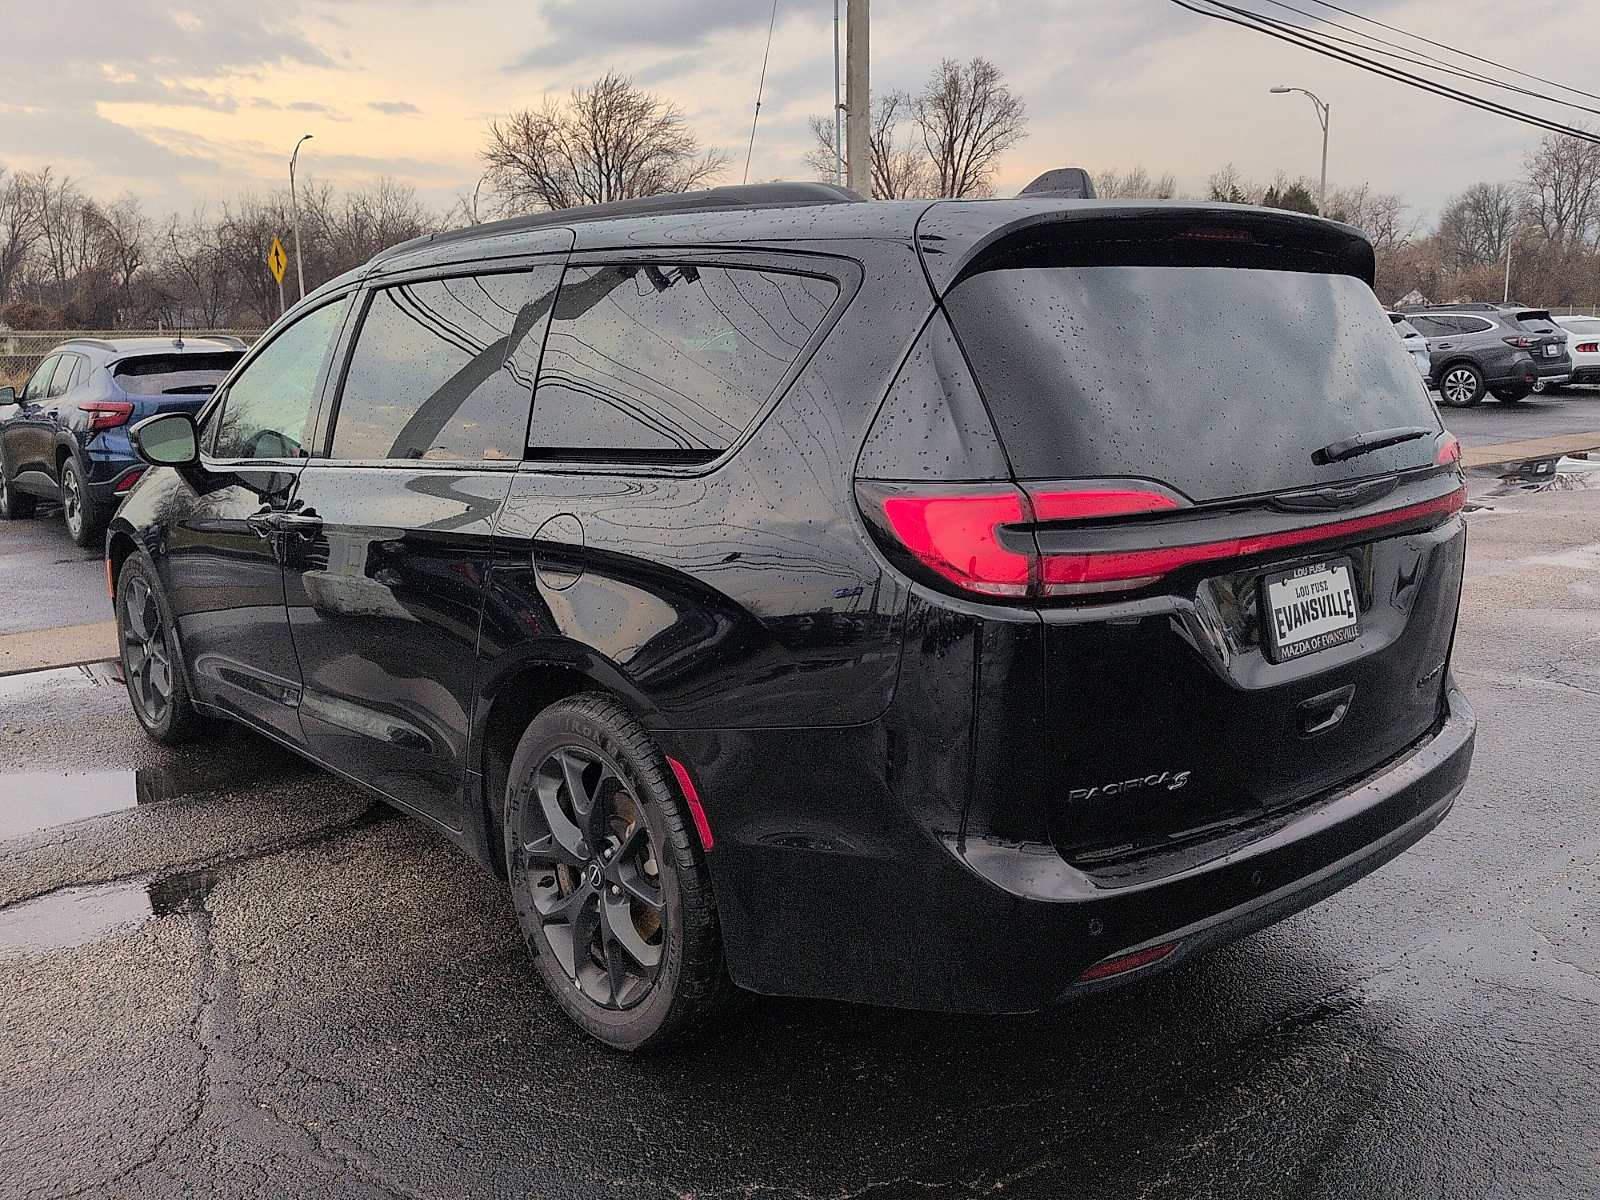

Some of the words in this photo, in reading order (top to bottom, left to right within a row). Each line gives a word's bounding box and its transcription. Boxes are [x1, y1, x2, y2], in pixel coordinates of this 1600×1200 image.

[1293, 566, 1308, 578] LOU
[1308, 563, 1327, 575] FUSZ
[1295, 586, 1310, 598] LOU
[1310, 580, 1329, 595] FUSZ
[1274, 589, 1354, 640] EVANSVILLE
[1281, 641, 1310, 659] MAZDA
[1311, 637, 1322, 650] OF
[1322, 626, 1359, 646] EVANSVILLE
[1069, 771, 1172, 803] PACIFICA
